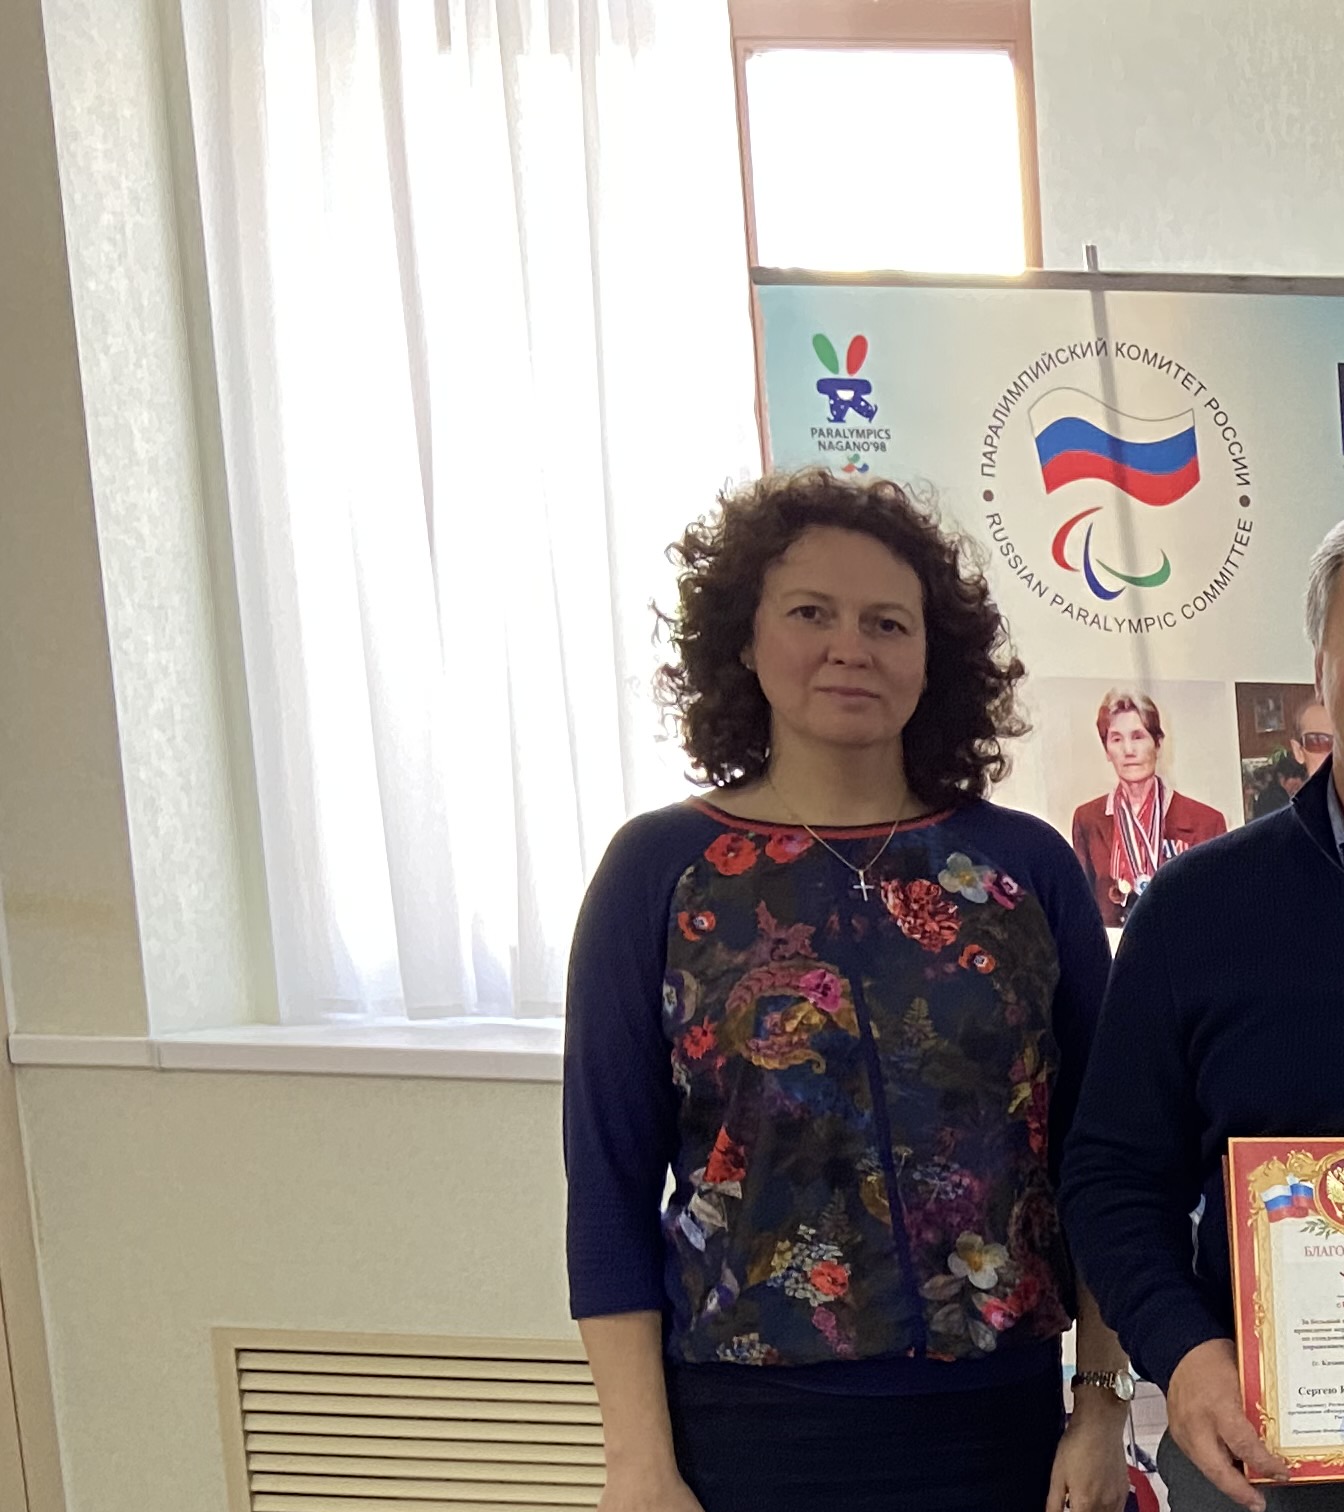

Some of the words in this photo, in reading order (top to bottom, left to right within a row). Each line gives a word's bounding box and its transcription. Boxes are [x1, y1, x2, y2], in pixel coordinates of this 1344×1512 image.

[810, 427, 891, 440] PARALYMPICS
[981, 337, 1108, 477] ПАРАЛИМПИЙСКИЙ
[1115, 341, 1207, 397] КОМИТЕТ
[1203, 397, 1251, 486] РОССИИ
[986, 512, 1050, 598] RUSSIAN
[1049, 593, 1177, 634] PARALYMPIC
[1181, 518, 1253, 620] COMMITTEE
[1298, 1386, 1338, 1397] Сергею
